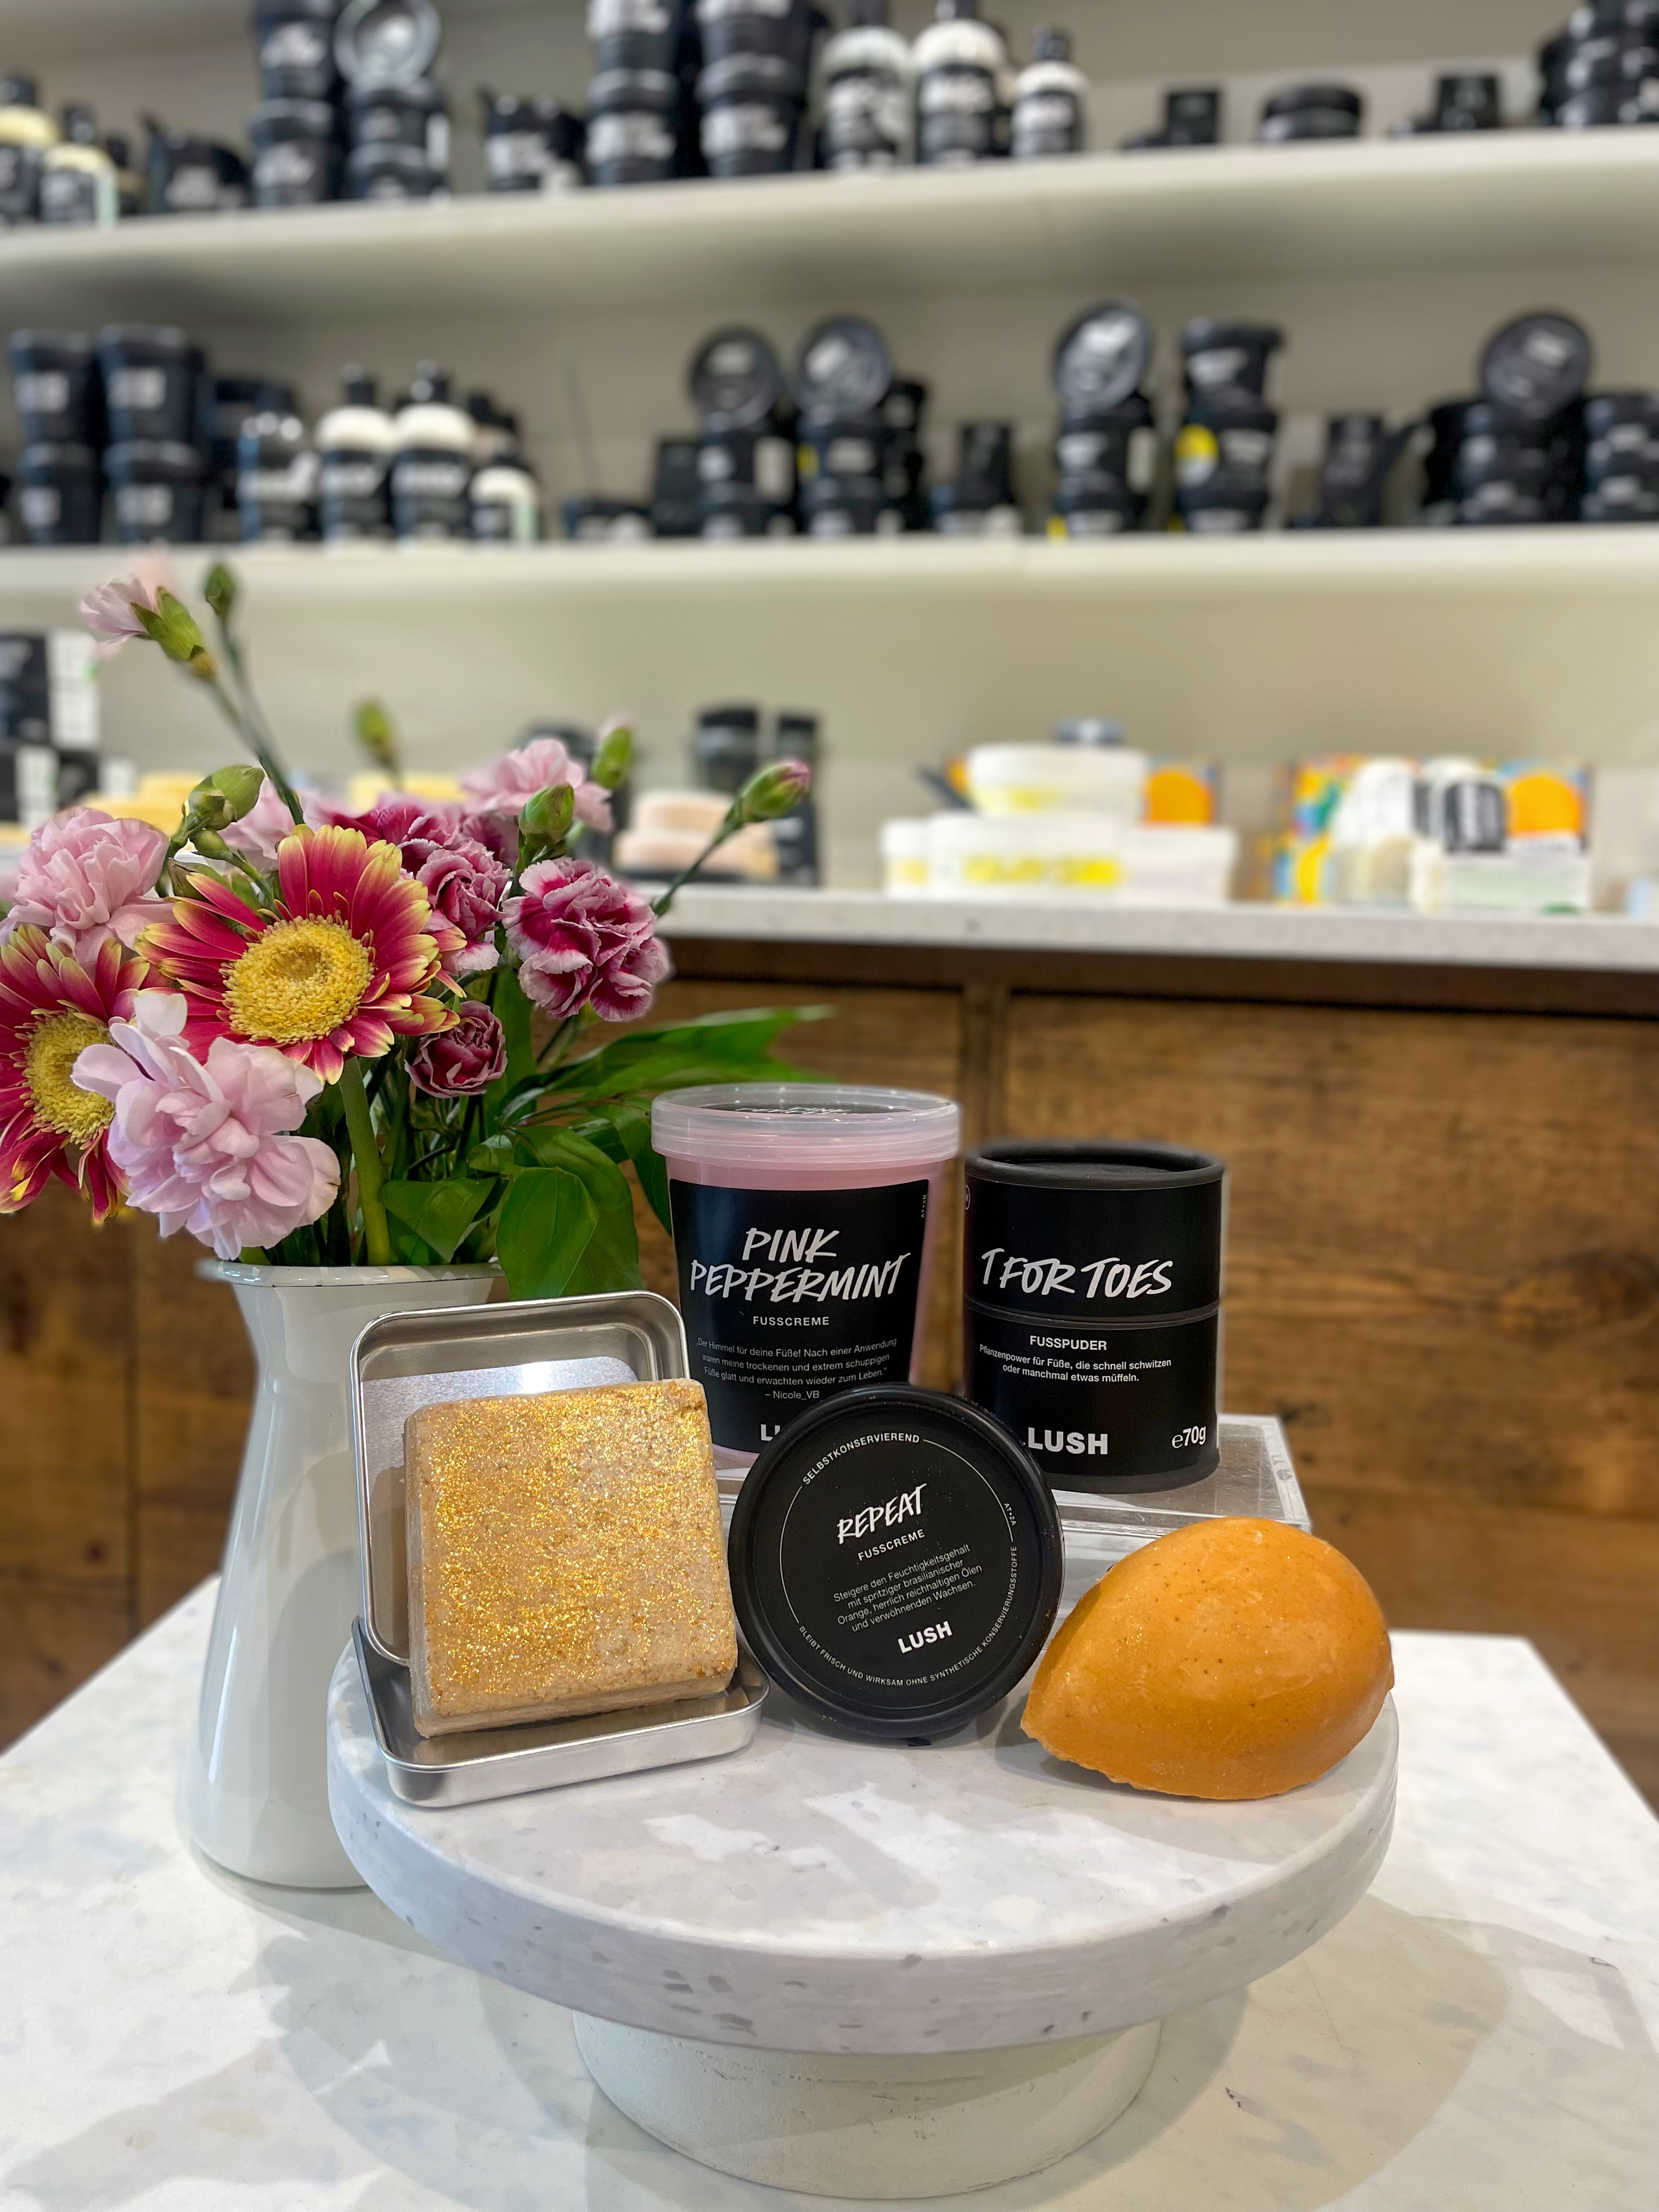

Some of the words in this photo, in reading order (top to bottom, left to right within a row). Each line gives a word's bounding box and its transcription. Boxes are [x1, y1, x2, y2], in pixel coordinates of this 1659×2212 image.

[742, 1227, 840, 1263] PINK
[690, 1252, 911, 1303] PEPPERMINT
[981, 1248, 1005, 1285] T
[1000, 1256, 1075, 1295] FOR
[1080, 1257, 1173, 1299] TOES
[753, 1316, 830, 1326] FUSSCREME
[709, 1340, 735, 1353] Himmel
[737, 1346, 747, 1355] für
[750, 1347, 773, 1357] deine
[776, 1348, 800, 1357] Füße!
[804, 1348, 828, 1357] Nach
[831, 1347, 852, 1356] einer
[854, 1339, 897, 1353] Anwendung
[980, 1344, 1031, 1363] Pflanzenpower
[1032, 1356, 1045, 1365] für
[1047, 1358, 1073, 1370] Füße,
[1075, 1361, 1090, 1369] die
[1093, 1361, 1126, 1370] schnell
[1128, 1359, 1171, 1369] schwitzen
[1030, 1335, 1107, 1351] FUSSPUDER
[702, 1353, 720, 1364] waren
[722, 1358, 744, 1368] meine
[746, 1362, 789, 1372] trockenen
[792, 1363, 809, 1372] und
[812, 1362, 843, 1371] extrem
[845, 1354, 890, 1369] schuppigen
[704, 1366, 720, 1378] Füße
[721, 1372, 737, 1381] glatt
[739, 1375, 754, 1384] und
[757, 1377, 803, 1385] erwachten
[805, 1376, 836, 1385] wieder
[838, 1374, 856, 1383] zum
[1003, 1364, 1020, 1374] oder
[1022, 1368, 1068, 1380] manchmal
[1071, 1373, 1099, 1382] etwas
[1102, 1373, 1139, 1382] müffeln.
[773, 1390, 820, 1400] Nicole_VB
[1028, 1427, 1108, 1454] LUSH
[803, 1432, 919, 1485] SELBSTKONSERVIEREND
[837, 1483, 927, 1544] REPEAT
[858, 1529, 925, 1561] FUSSCREME
[833, 1583, 869, 1602] Steigere
[871, 1576, 887, 1588] den
[888, 1544, 970, 1582] Feuchtigkeitsgehalt
[847, 1598, 862, 1609] mit
[863, 1583, 901, 1605] spritziger
[905, 1560, 963, 1587] brasilianischer
[837, 1608, 872, 1625] Orange,
[873, 1594, 905, 1612] herrlich
[906, 1573, 960, 1600] reichhaltigen
[962, 1564, 983, 1578] Ölen
[852, 1619, 868, 1632] und
[870, 1596, 932, 1624] verwöhnenden
[933, 1579, 976, 1601] Wachsen.
[799, 1626, 821, 1650] BLEIBT
[820, 1649, 846, 1671] FRISCH
[847, 1667, 864, 1679] UND
[866, 1674, 903, 1686] WIRKSAM
[906, 1674, 928, 1685] OHNE
[930, 1645, 983, 1682] SYNTHETISCHE
[981, 1545, 1017, 1647] KONSERVIERUNGSSTOFFE
[898, 1621, 953, 1654] LUSH
